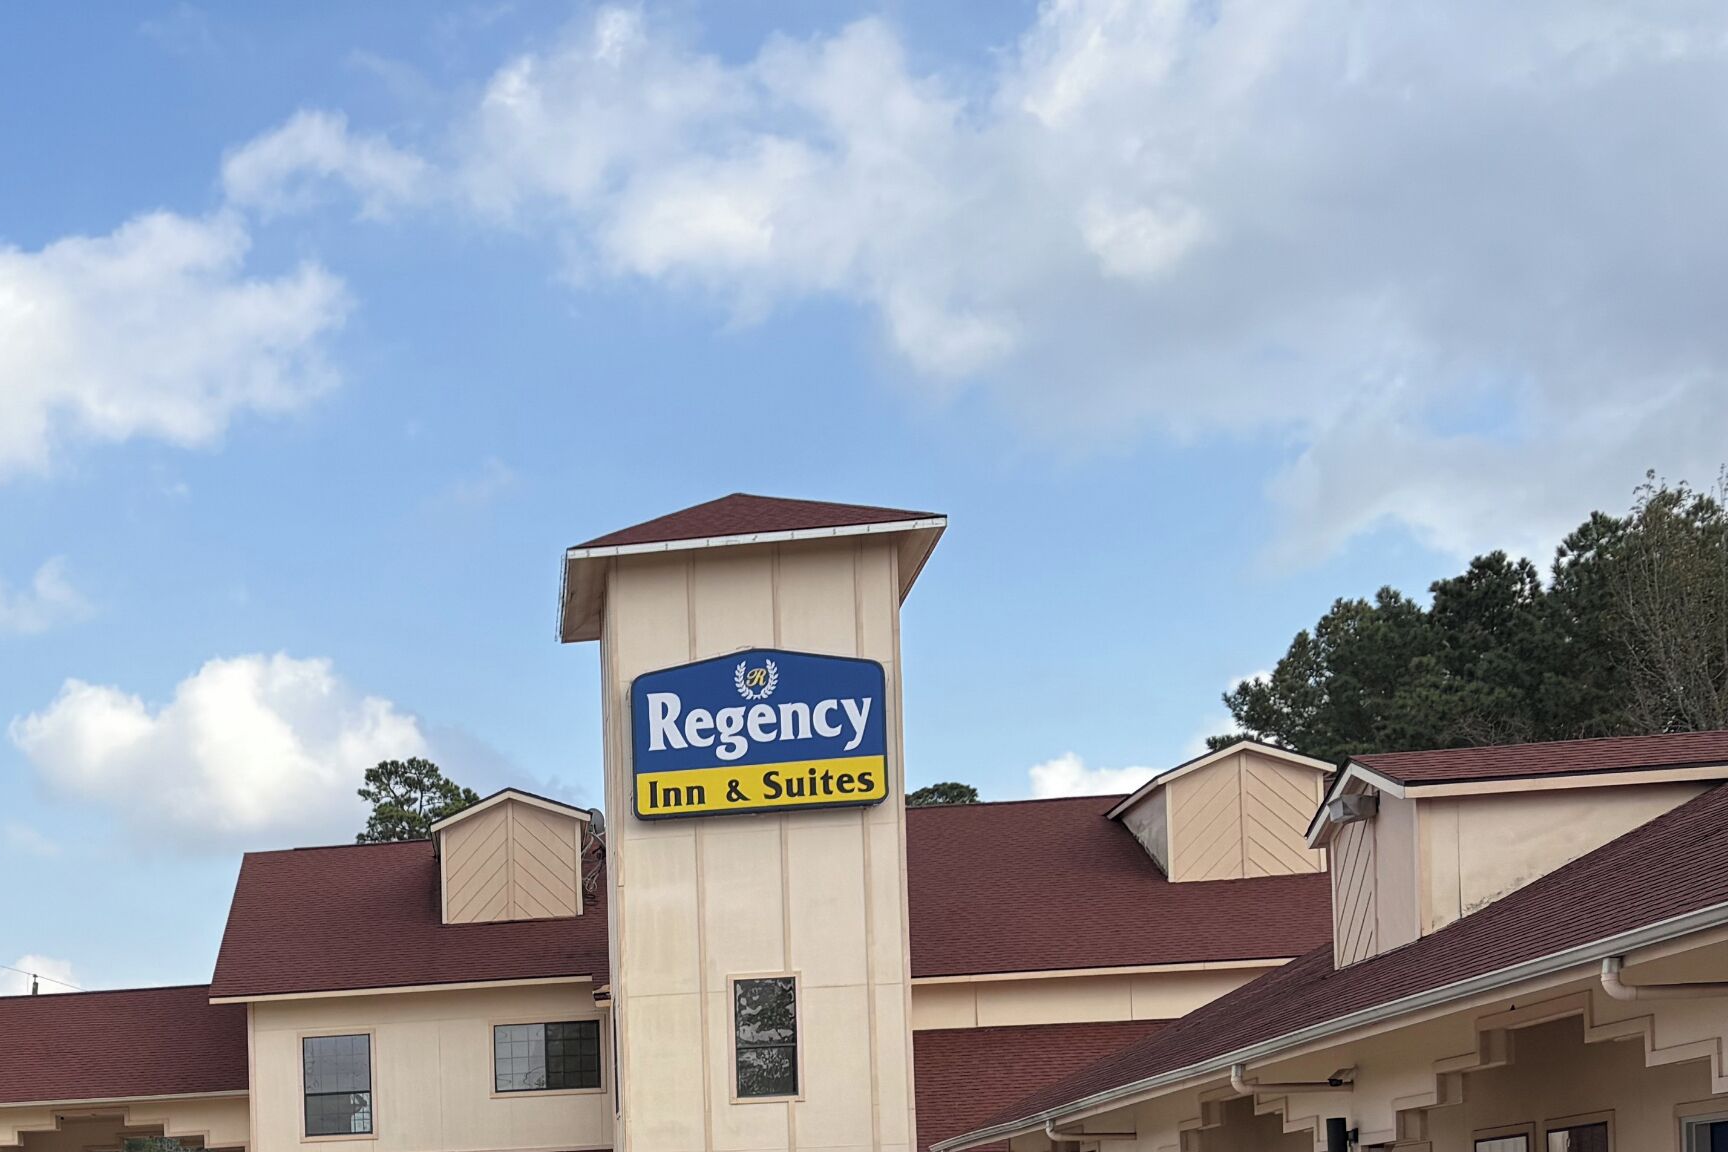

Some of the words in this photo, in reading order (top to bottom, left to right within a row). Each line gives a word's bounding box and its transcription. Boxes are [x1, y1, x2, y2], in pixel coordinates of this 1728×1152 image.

[647, 692, 872, 761] Regency
[649, 780, 706, 809] Inn
[725, 778, 751, 803] &
[762, 767, 875, 800] Suites
